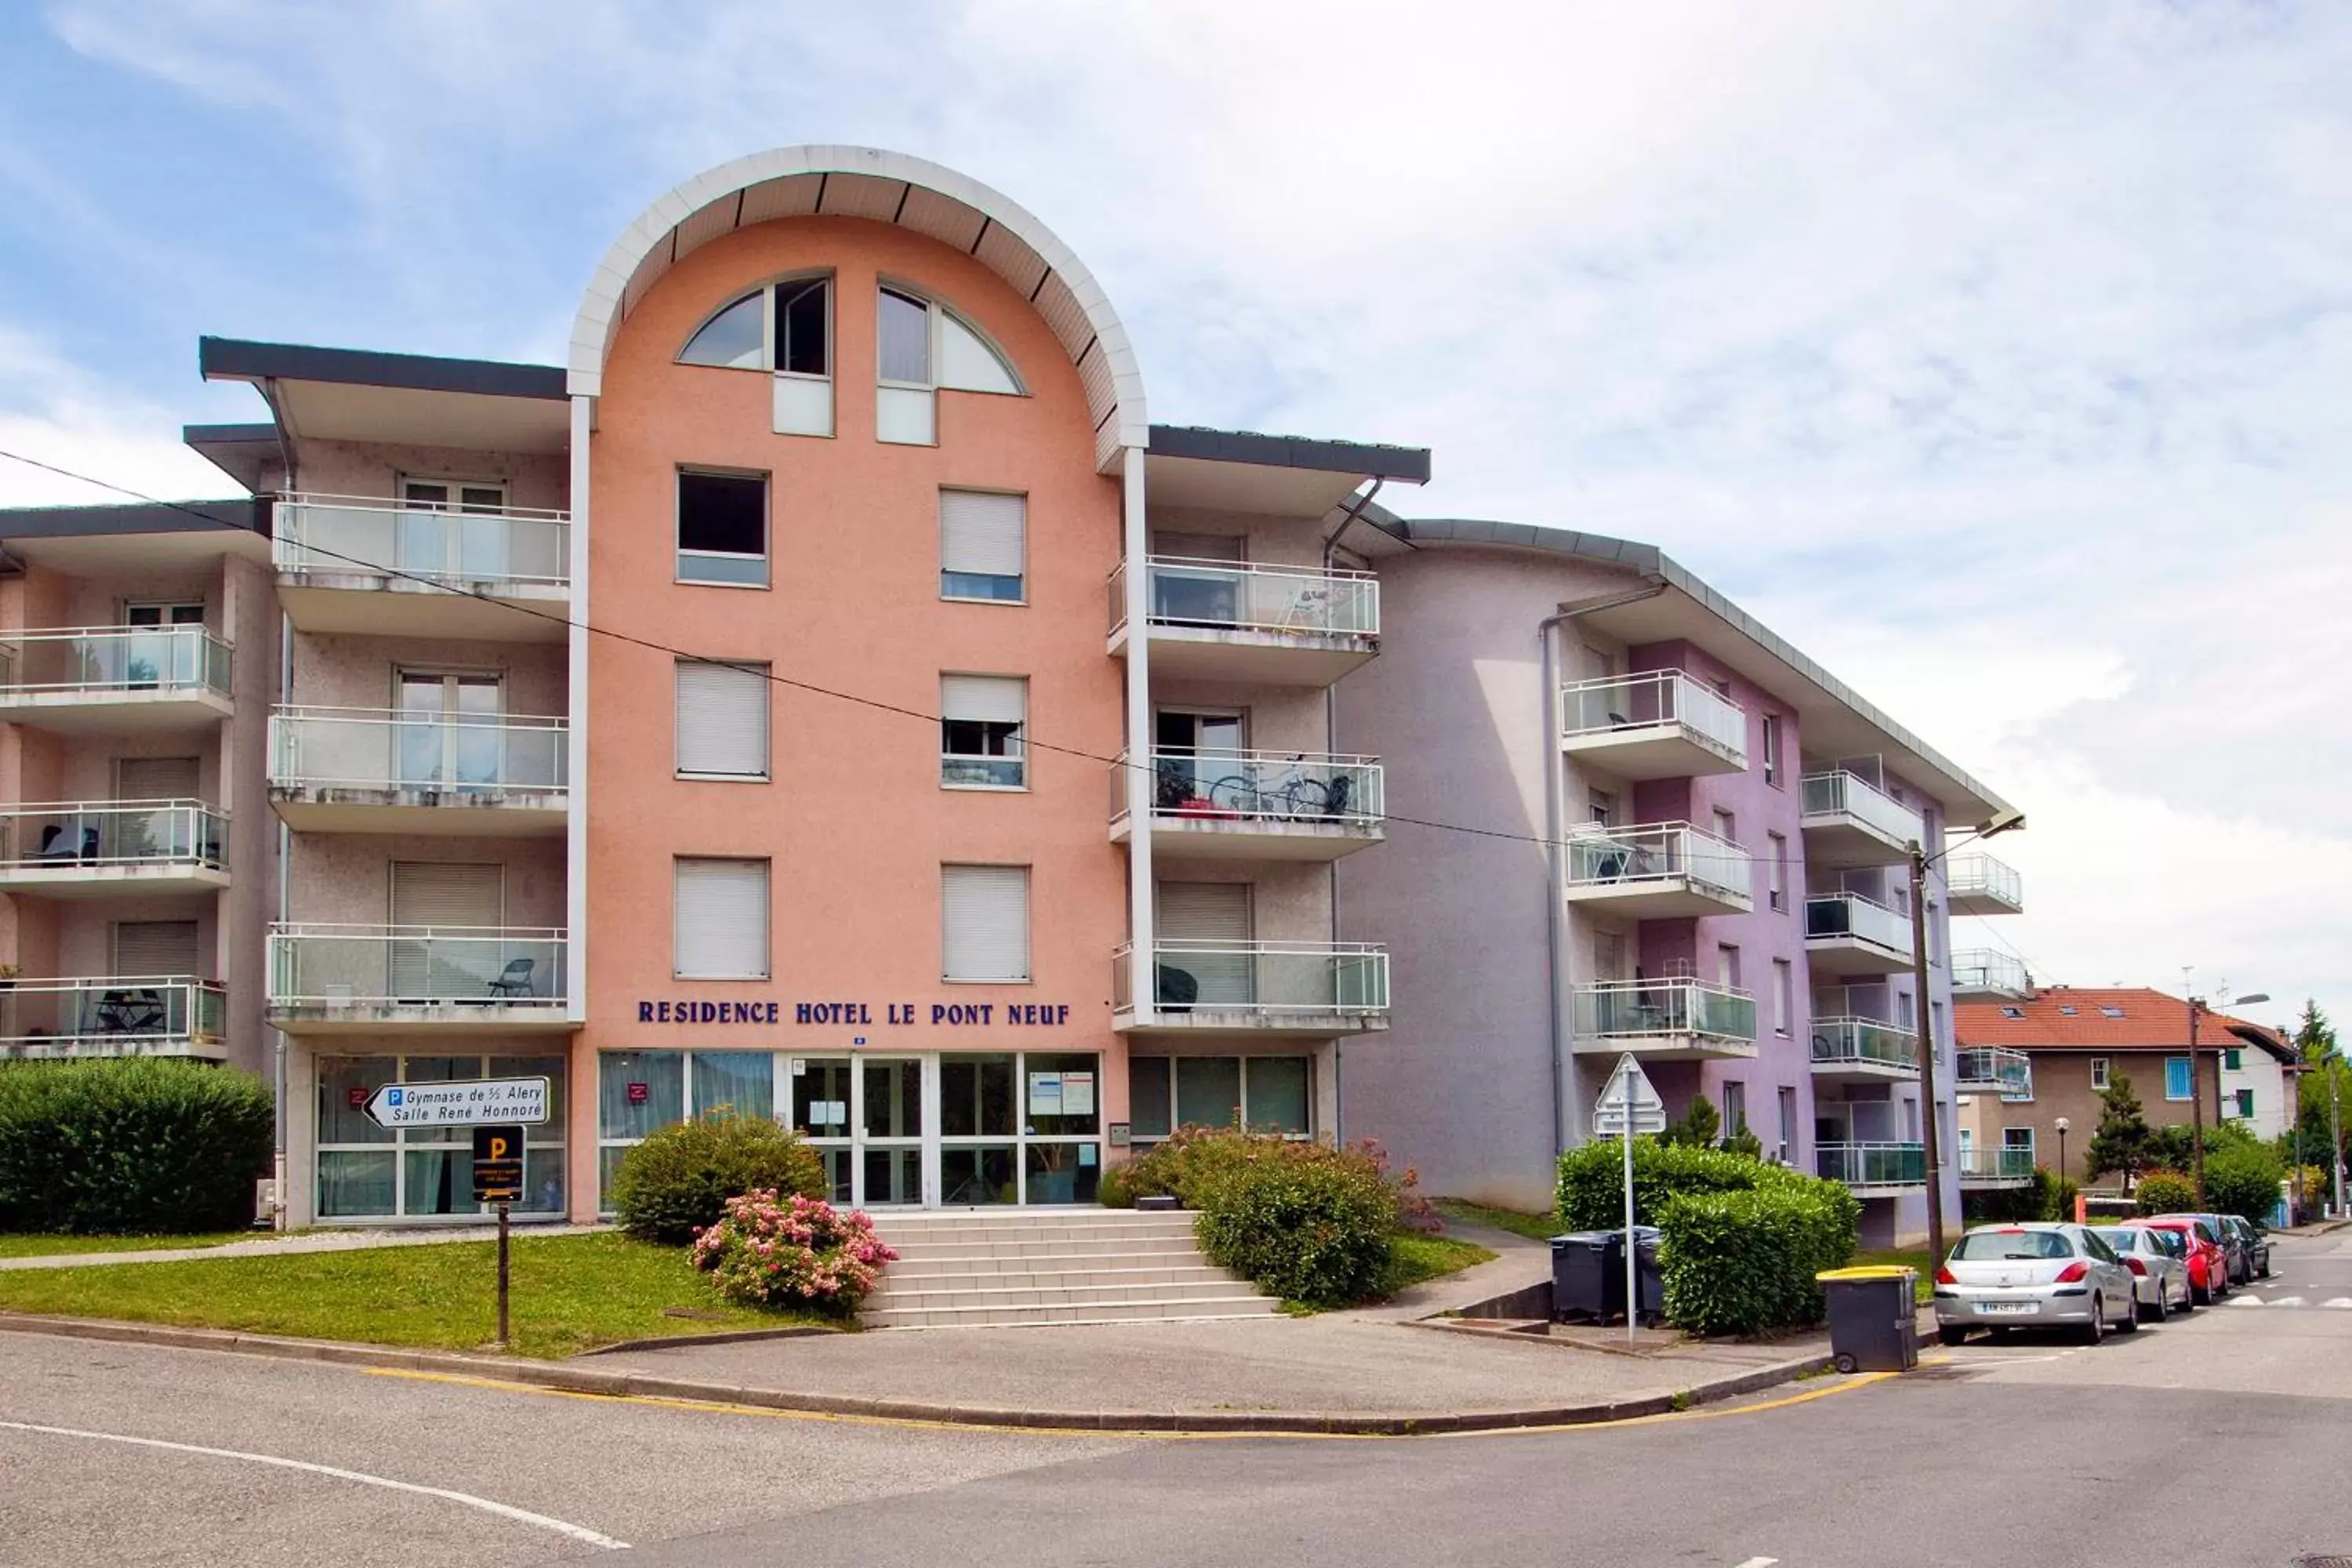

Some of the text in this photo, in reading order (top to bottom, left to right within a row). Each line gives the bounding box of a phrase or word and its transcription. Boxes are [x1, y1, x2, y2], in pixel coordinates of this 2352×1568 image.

[638, 1001, 1069, 1025] RESIDENCE HOTEL LE PONT NEUF
[407, 1091, 463, 1106] Gymnase
[470, 1088, 485, 1102] de
[507, 1085, 542, 1101] Alery
[393, 1103, 542, 1121] Salle René Honnoré
[491, 1138, 507, 1163] P
